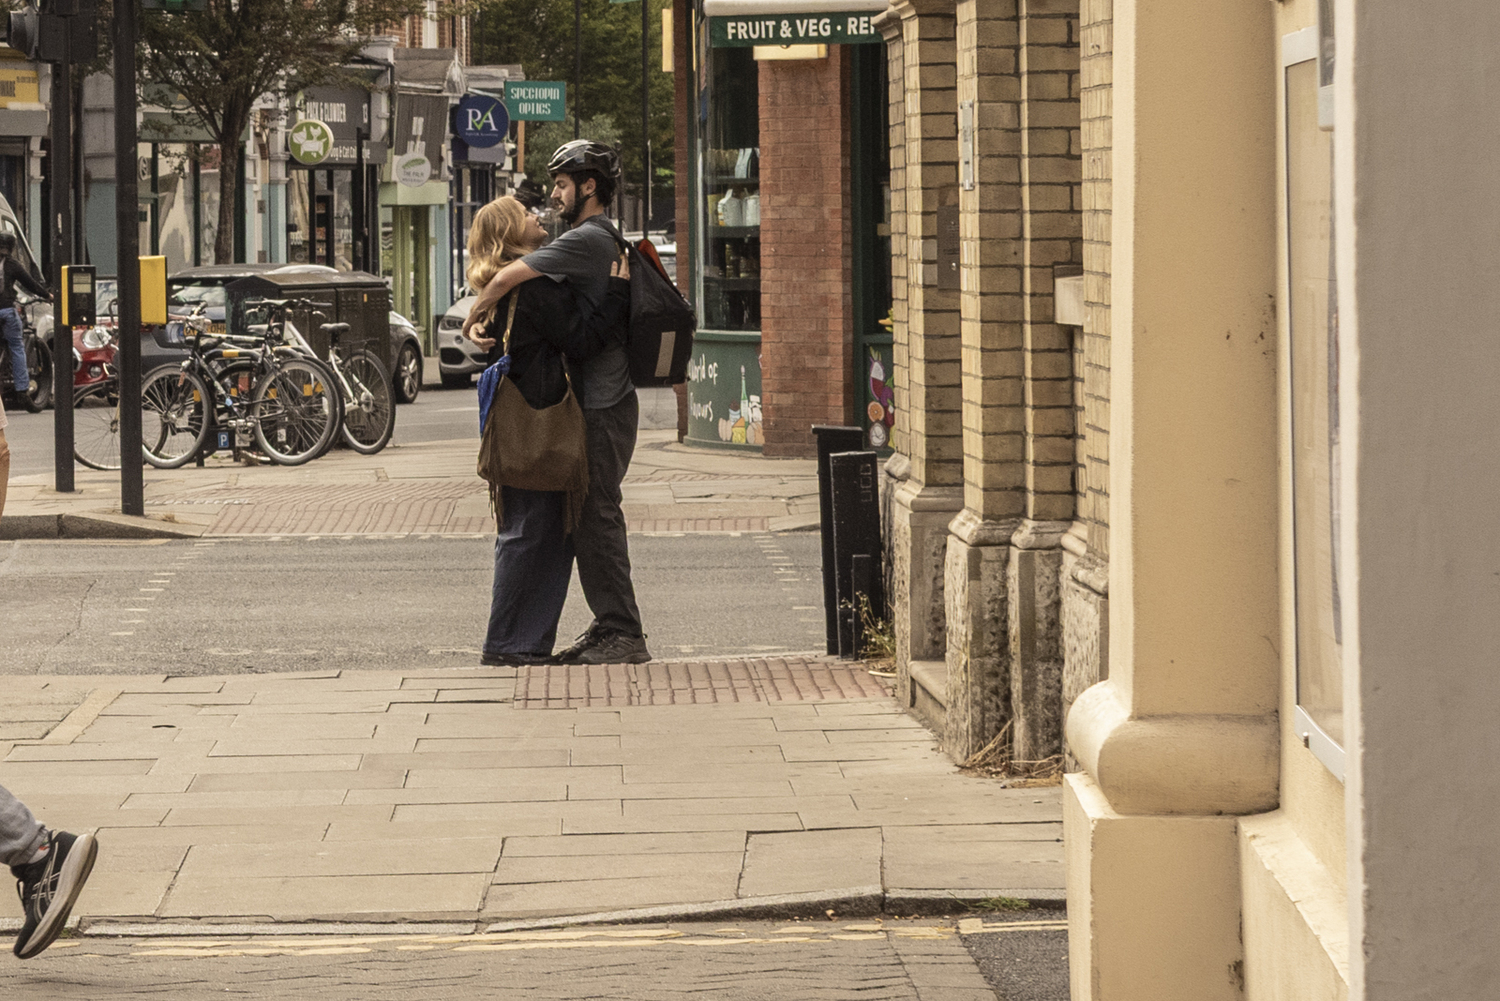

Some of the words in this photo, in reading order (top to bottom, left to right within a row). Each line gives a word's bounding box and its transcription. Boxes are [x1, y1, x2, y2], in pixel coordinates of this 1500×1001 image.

[726, 20, 776, 40] FRUIT
[779, 19, 792, 38] &
[795, 18, 831, 37] VEG
[708, 362, 719, 385] of
